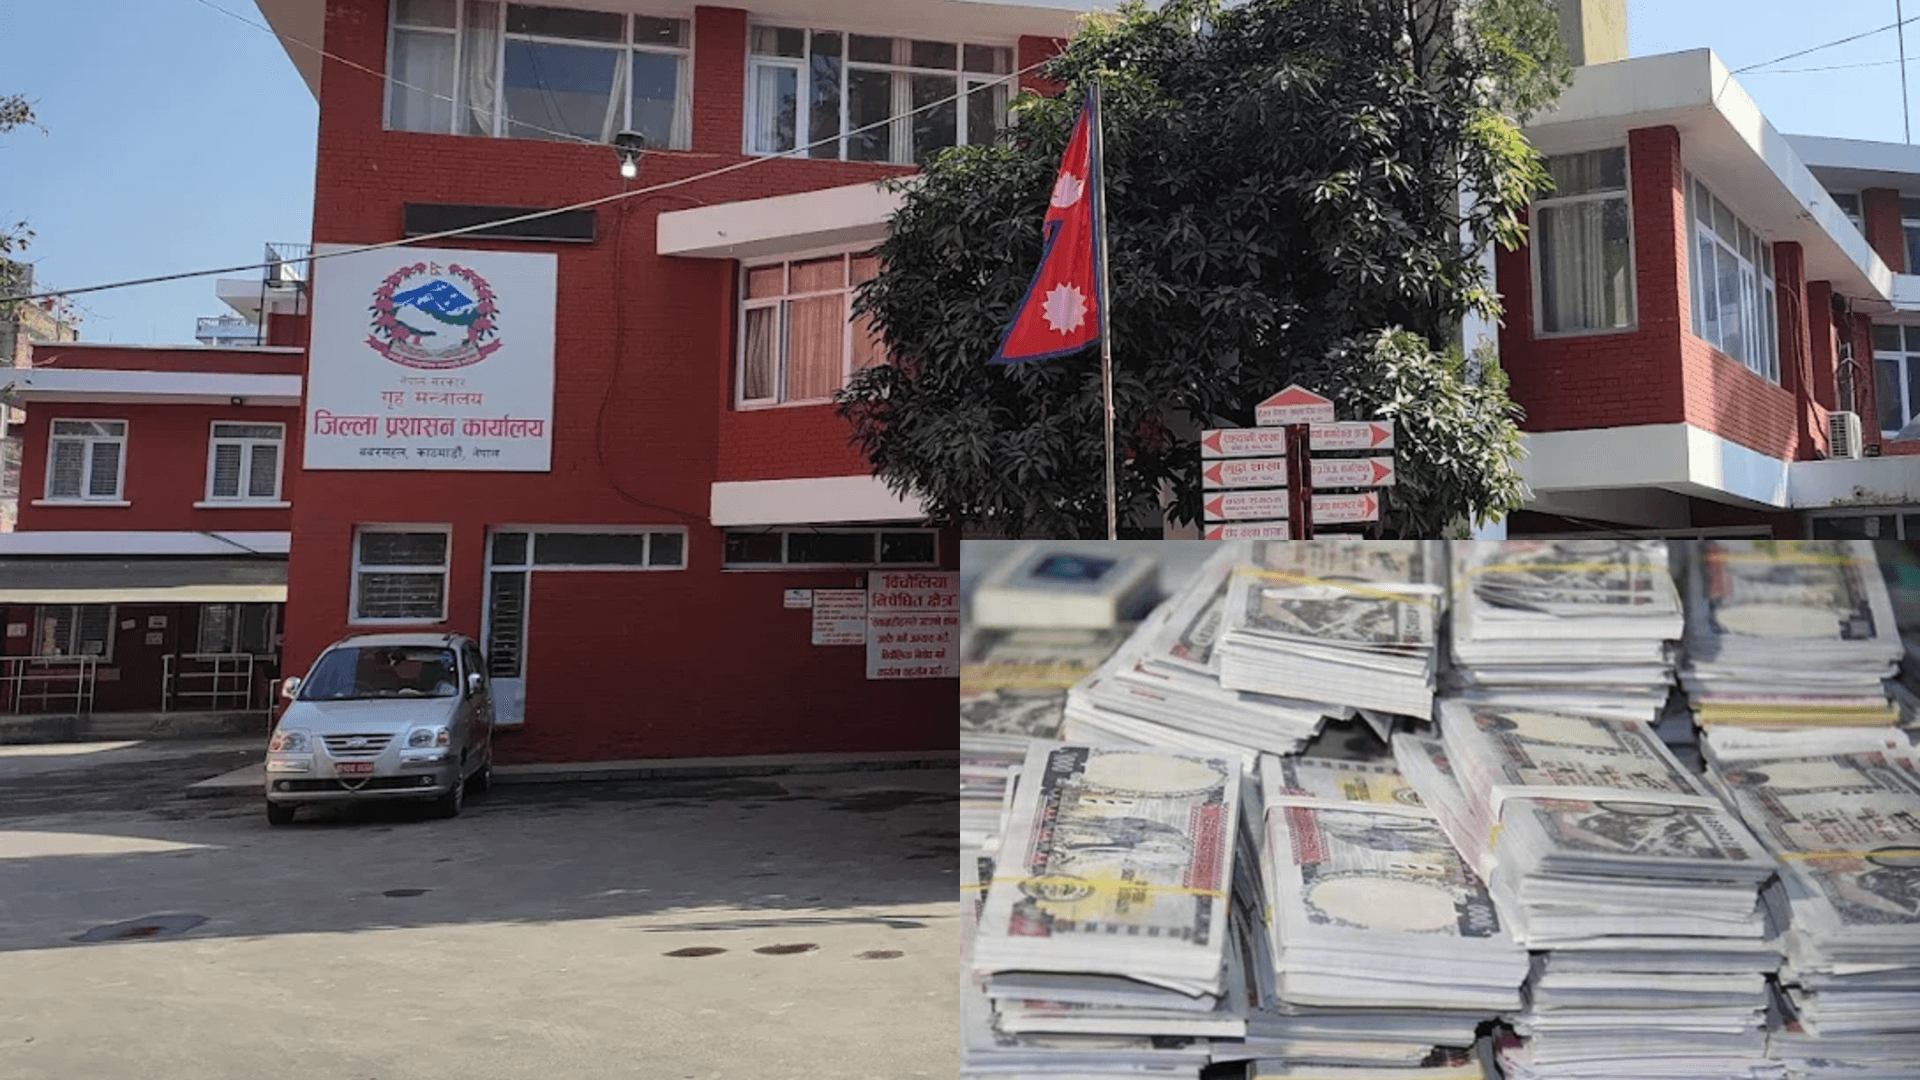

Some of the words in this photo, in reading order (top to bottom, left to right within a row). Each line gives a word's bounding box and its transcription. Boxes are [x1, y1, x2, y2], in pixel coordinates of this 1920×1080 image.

[381, 390, 405, 410] गृह
[415, 391, 484, 406] मन्त्रालय
[314, 409, 379, 436] जिल्ला
[386, 416, 455, 438] प्रशासन
[462, 414, 545, 438] कार्यालय
